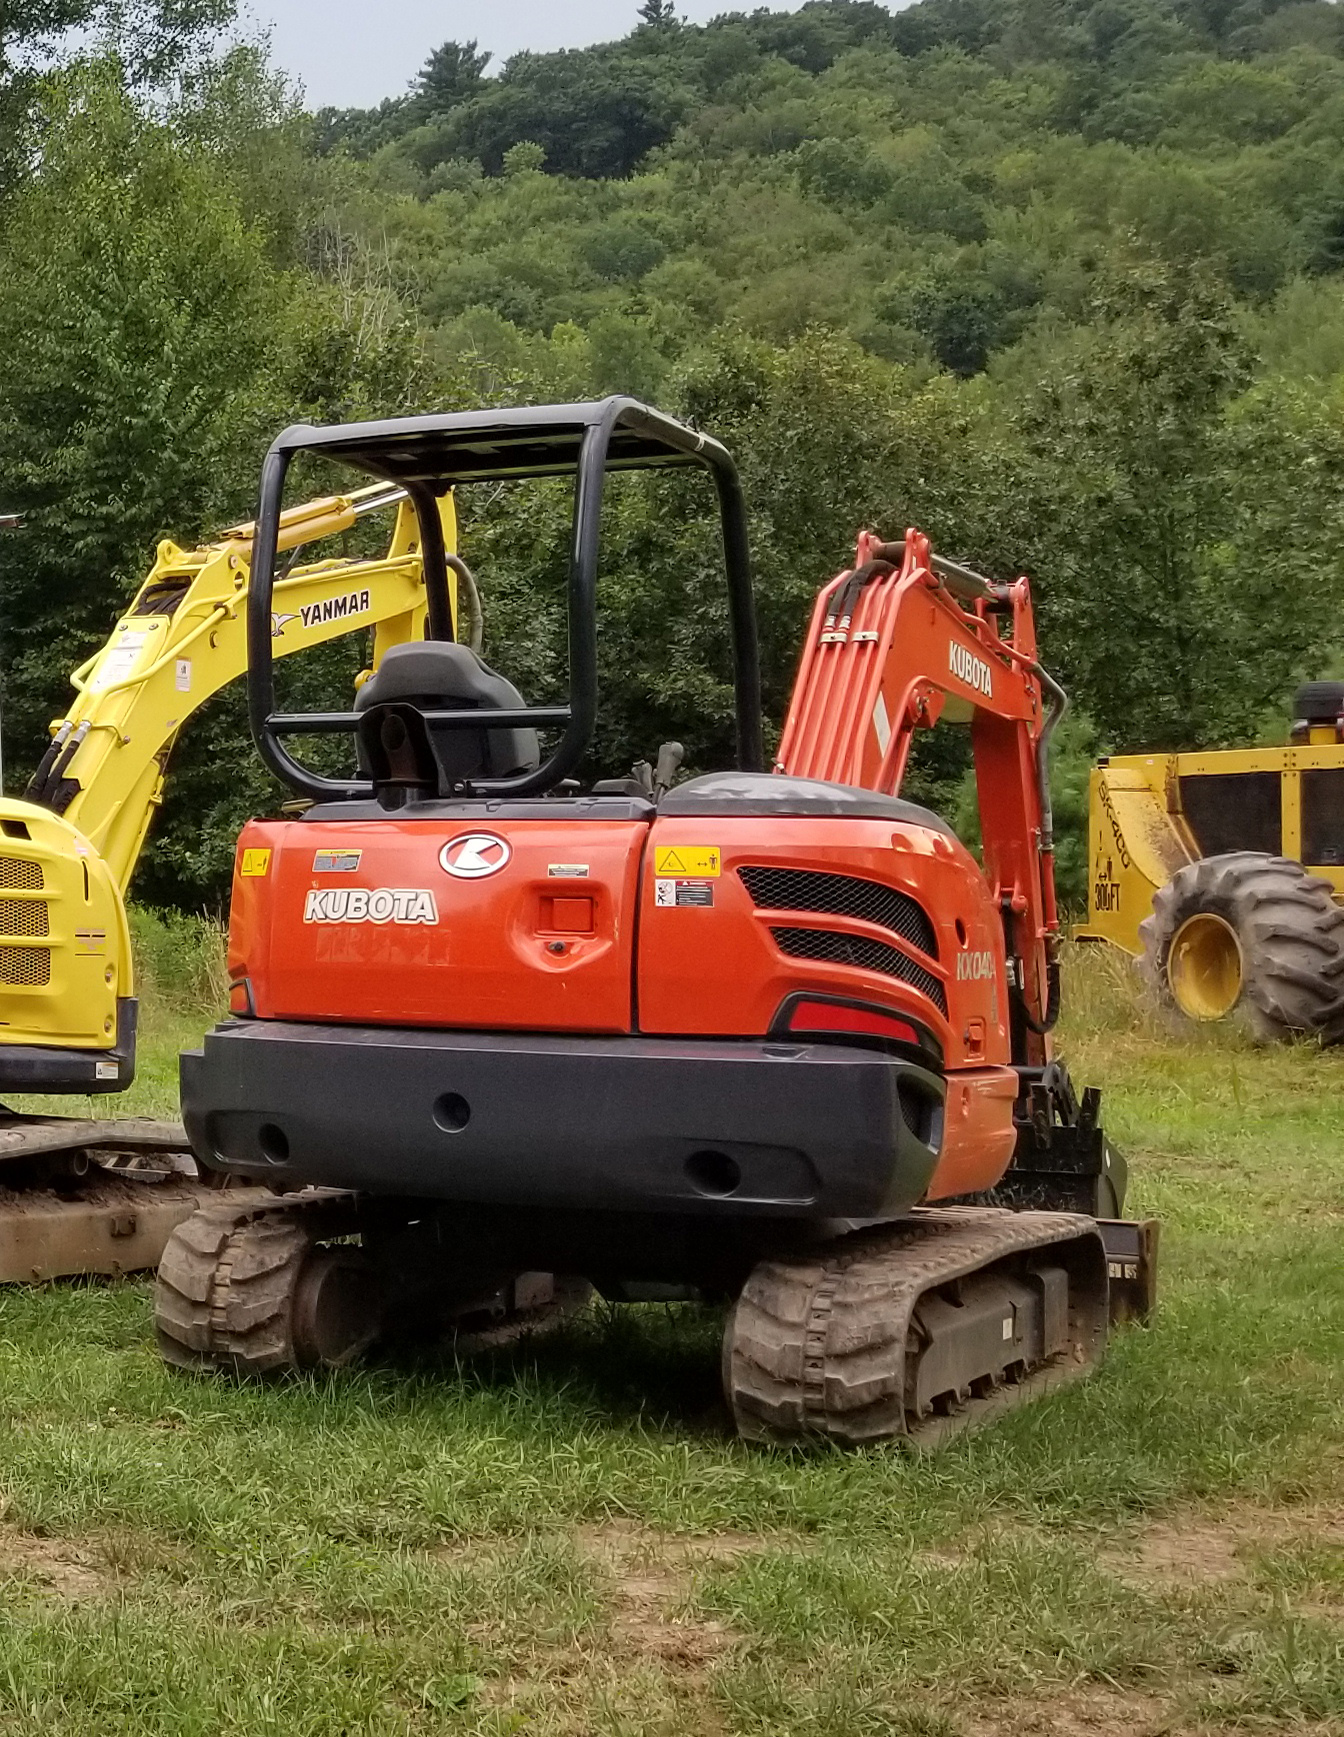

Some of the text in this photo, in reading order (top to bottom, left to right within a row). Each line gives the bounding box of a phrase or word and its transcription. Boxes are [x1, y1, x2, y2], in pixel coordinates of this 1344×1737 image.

[300, 590, 369, 627] YANMAR
[949, 640, 993, 699] KUBOTA
[305, 890, 435, 921] KUBOTA
